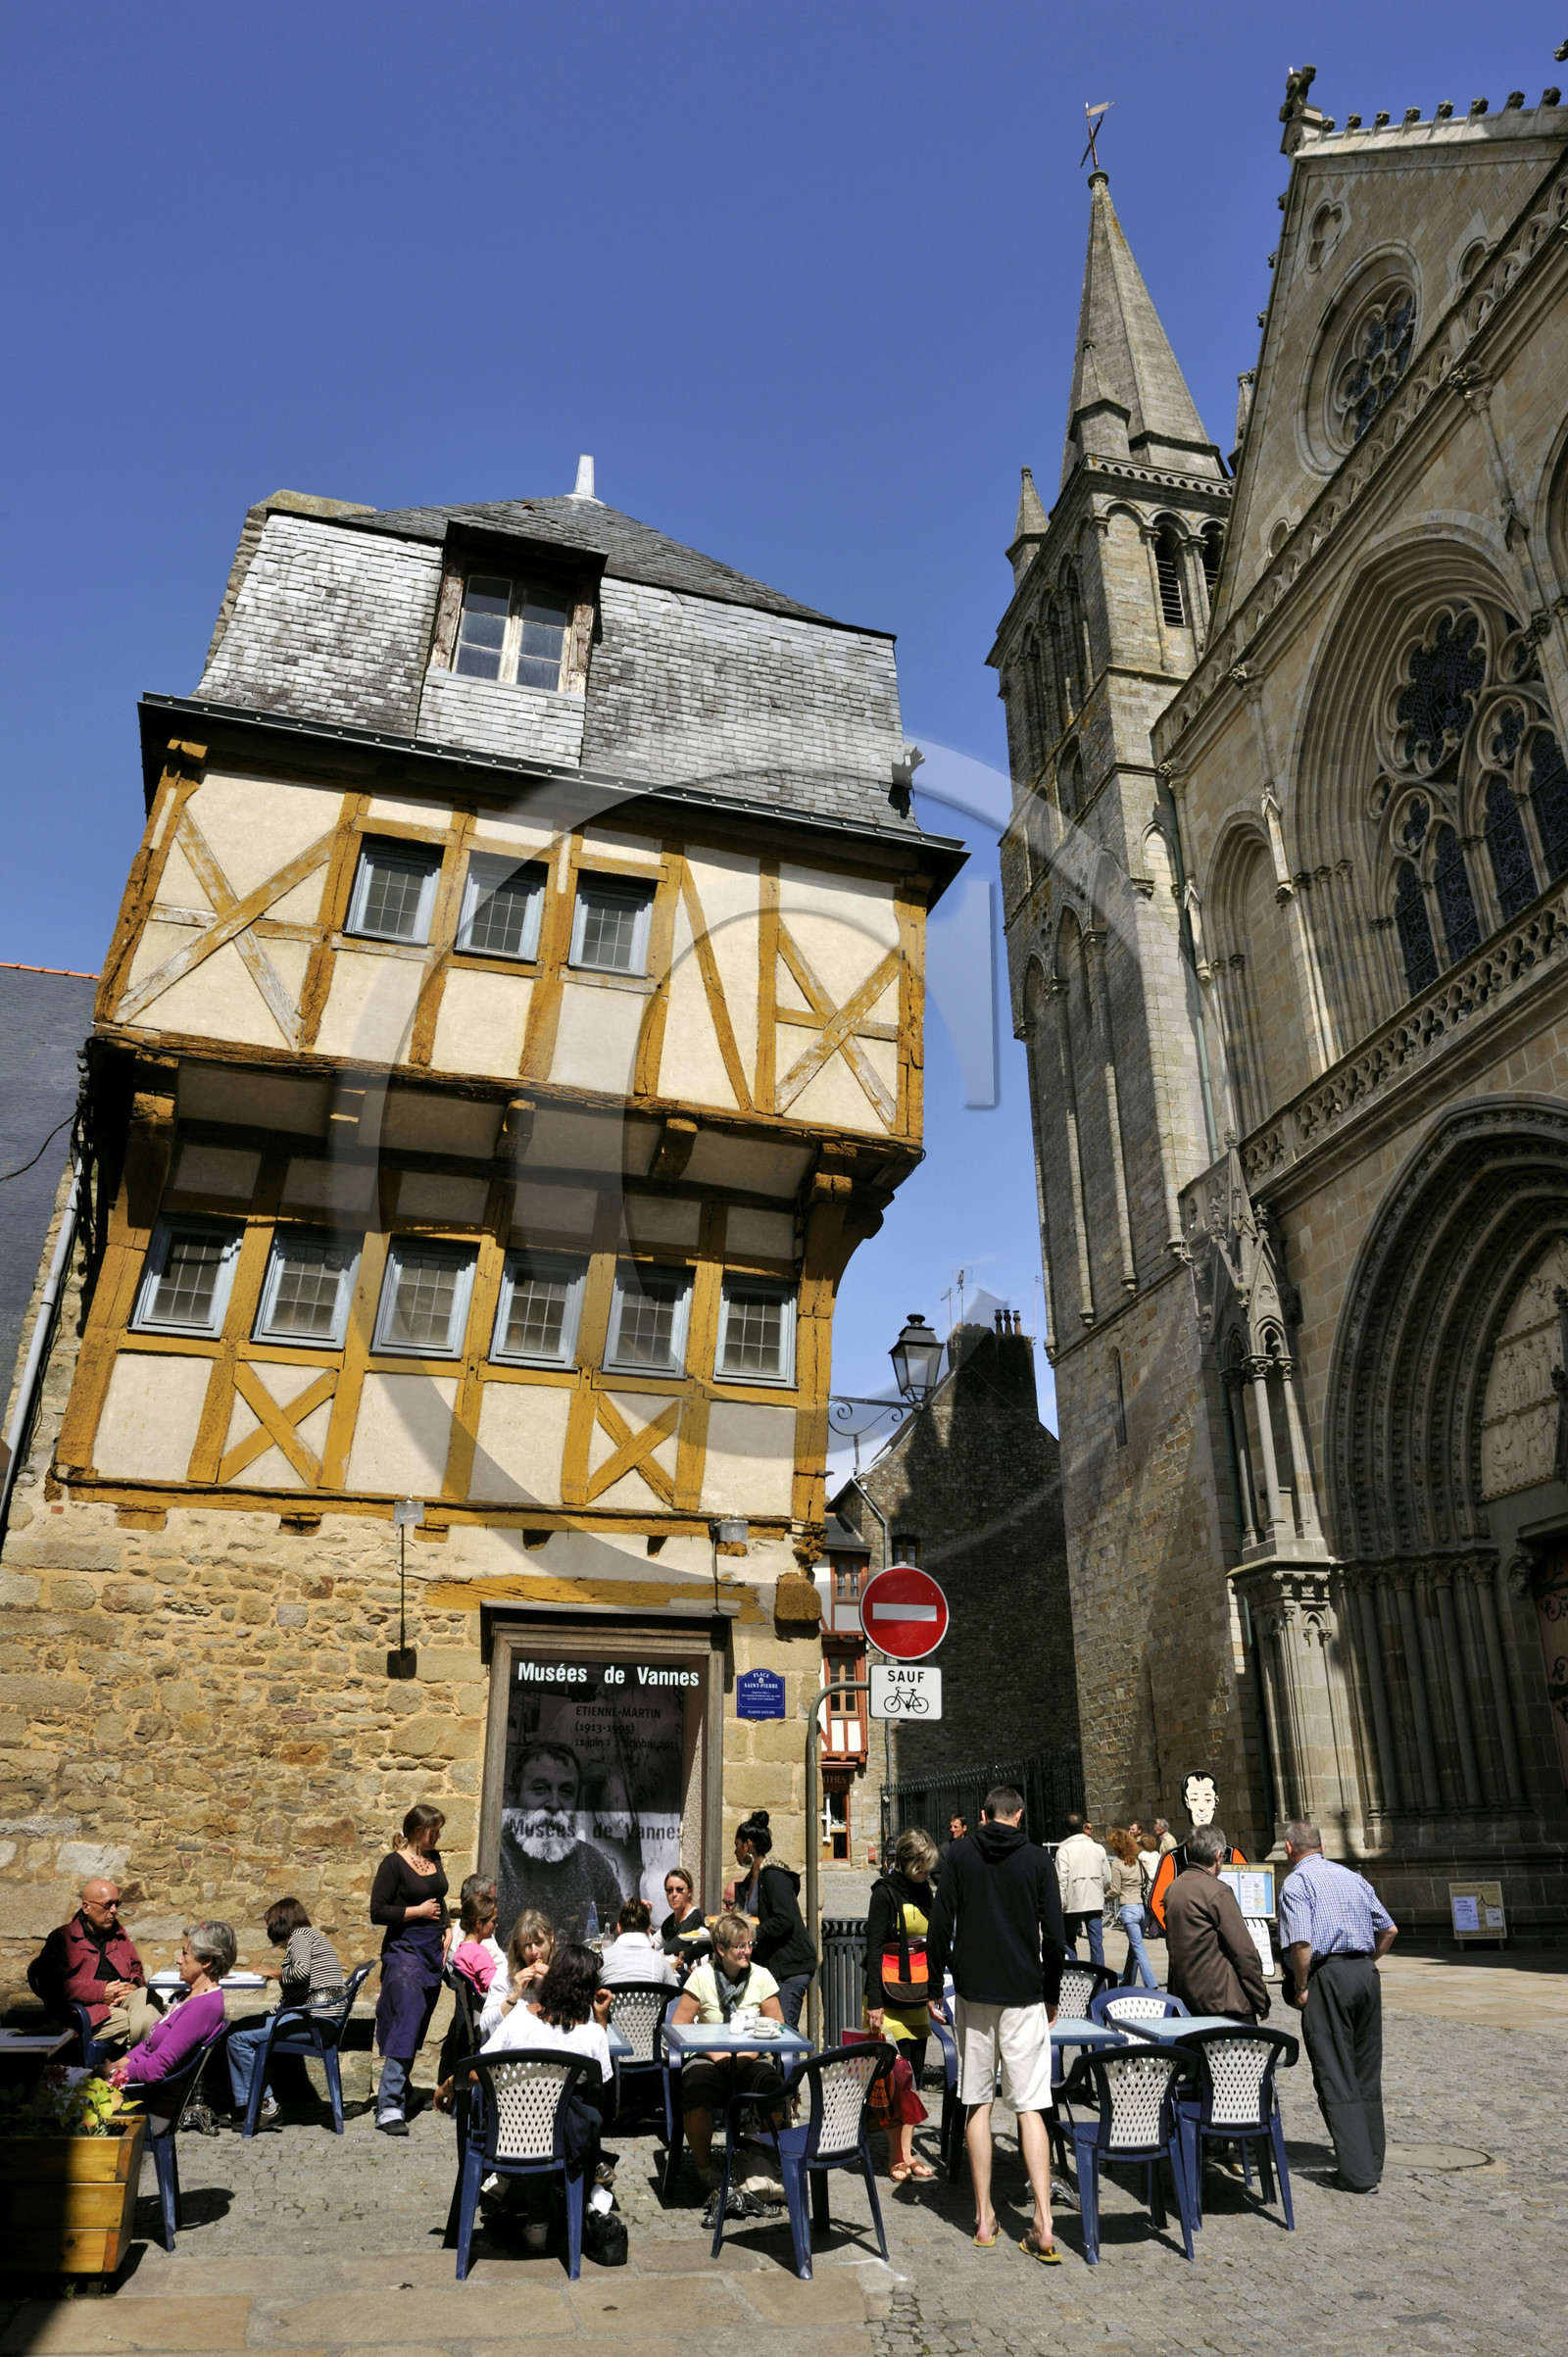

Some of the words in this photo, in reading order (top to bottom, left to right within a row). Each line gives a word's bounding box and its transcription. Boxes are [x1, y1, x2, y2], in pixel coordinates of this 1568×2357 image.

[517, 1662, 587, 1683] Musées
[604, 1666, 625, 1684] de
[637, 1666, 700, 1687] Vannes
[888, 1670, 925, 1683] SAUF
[575, 1705, 662, 1719] ETIENNE-MARTIN
[593, 1825, 612, 1839] de
